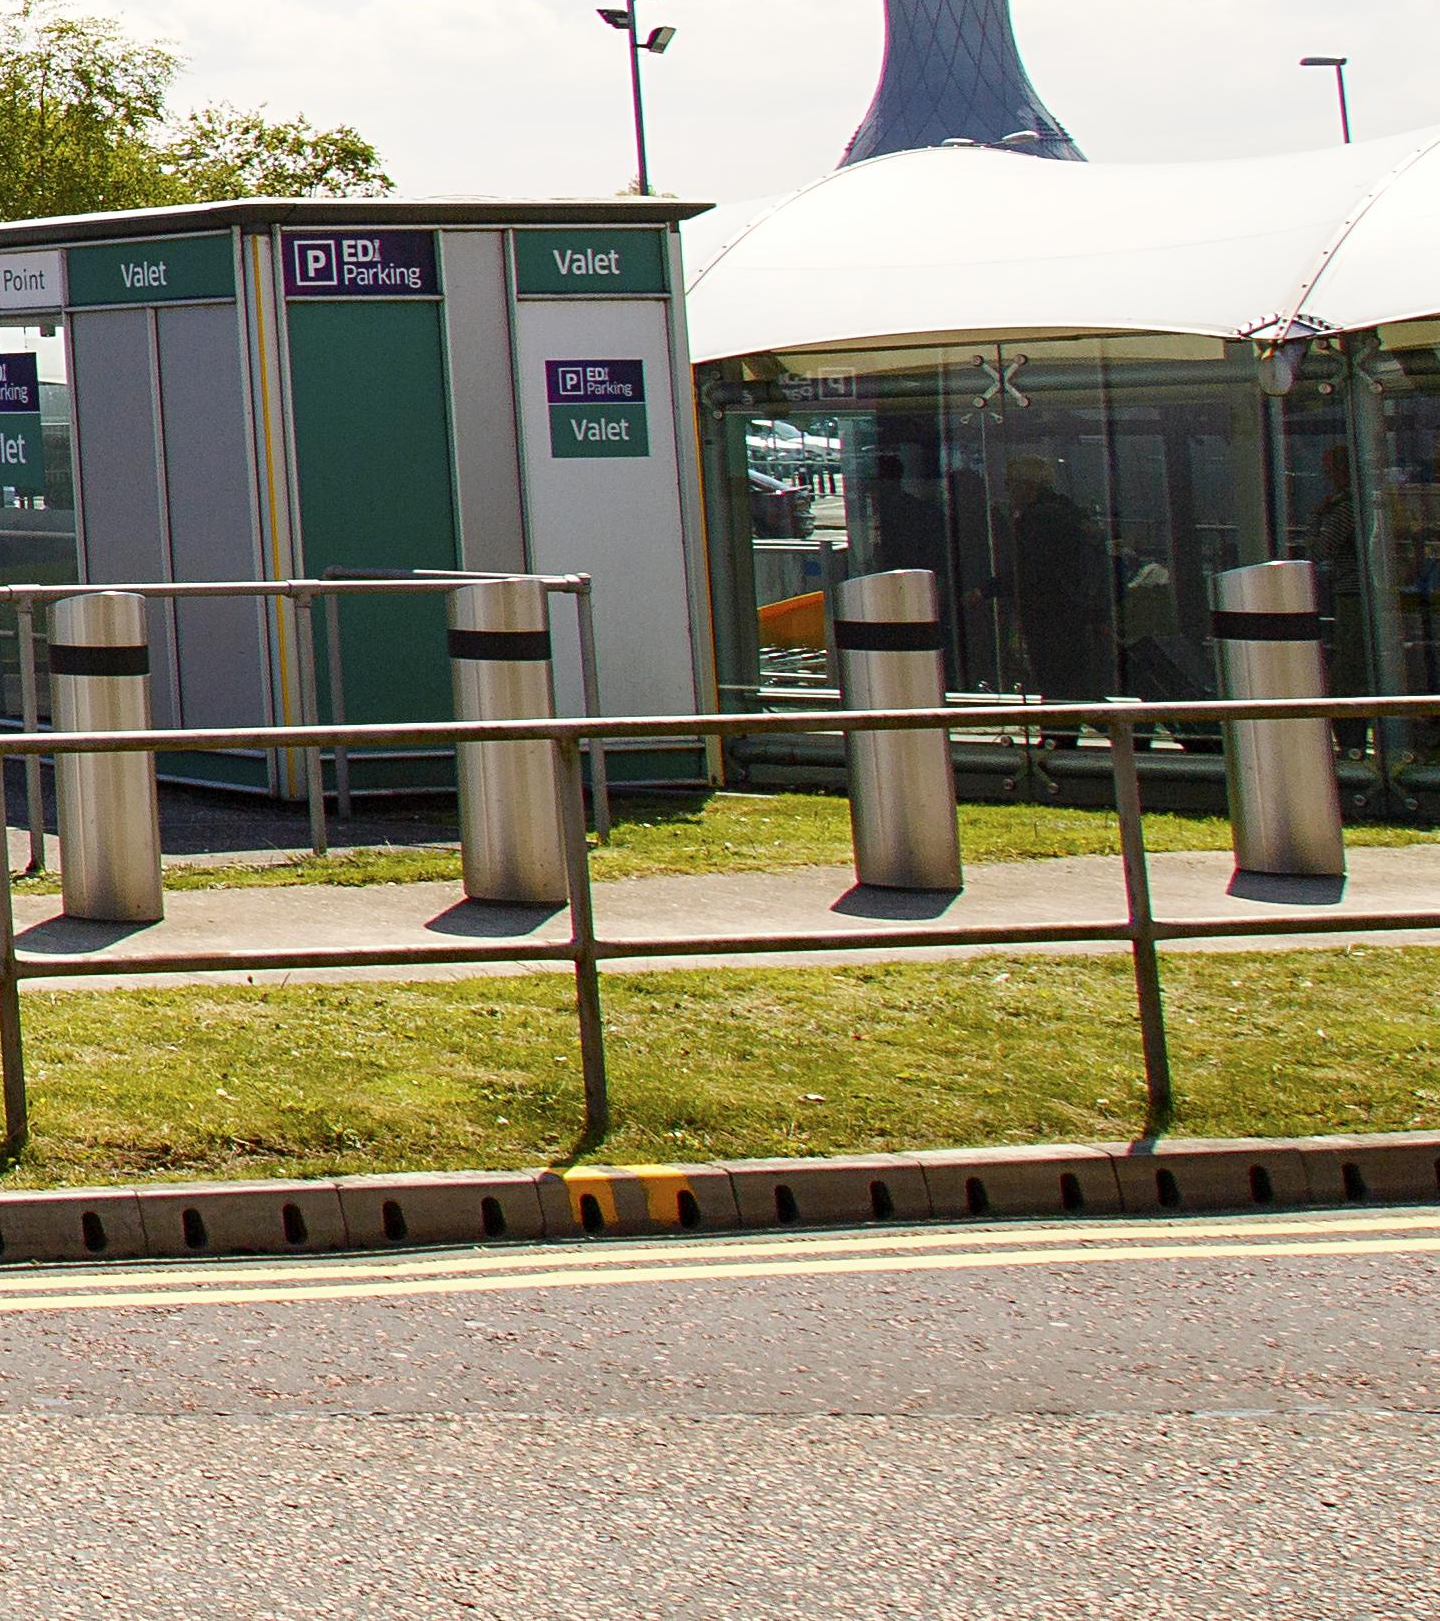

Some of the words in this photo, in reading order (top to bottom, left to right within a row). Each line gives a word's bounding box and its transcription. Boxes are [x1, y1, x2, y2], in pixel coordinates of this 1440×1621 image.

[307, 250, 326, 278] P
[552, 248, 621, 275] Valet
[3, 268, 45, 292] Point
[121, 260, 167, 288] Valet
[344, 264, 422, 288] Parking
[565, 373, 578, 390] P
[587, 381, 633, 396] Parking
[570, 418, 630, 441] Valet
